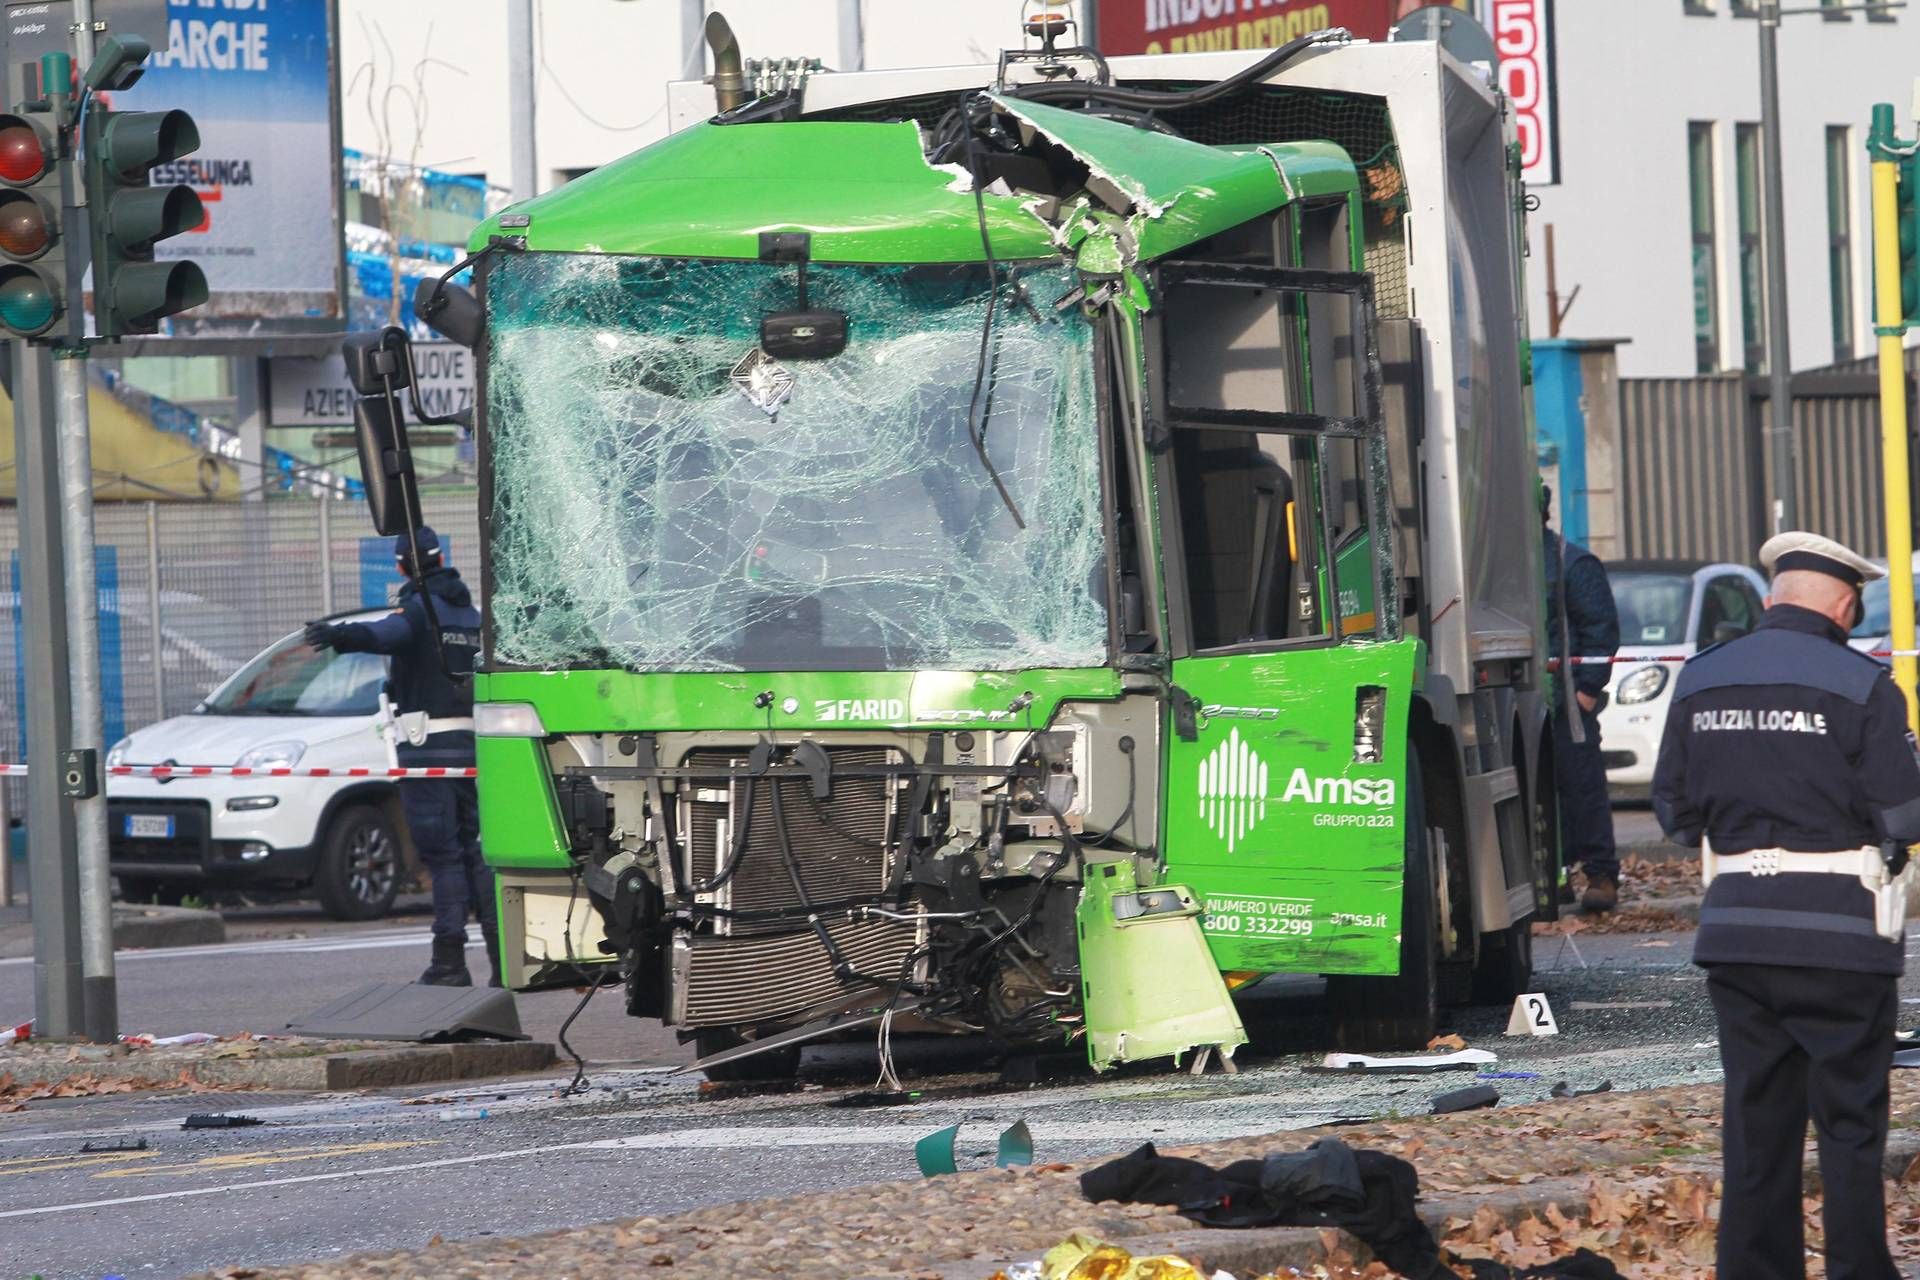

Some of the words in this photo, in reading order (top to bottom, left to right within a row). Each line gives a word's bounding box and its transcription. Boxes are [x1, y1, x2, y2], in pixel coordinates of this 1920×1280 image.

[144, 19, 268, 70] ARCHE
[413, 350, 465, 379] UOVE
[838, 699, 904, 721] FARID
[1693, 709, 1754, 733] POLIZIA
[1758, 709, 1827, 735] LOCALE
[1282, 767, 1395, 805] Amsa
[1313, 814, 1364, 827] GRUPPO
[1366, 814, 1395, 828] a2a
[1206, 899, 1266, 914] NUMERO
[1204, 914, 1241, 932] 800
[1244, 916, 1313, 936] 332299
[1330, 911, 1388, 928] amsa.it
[1529, 998, 1549, 1027] 2
